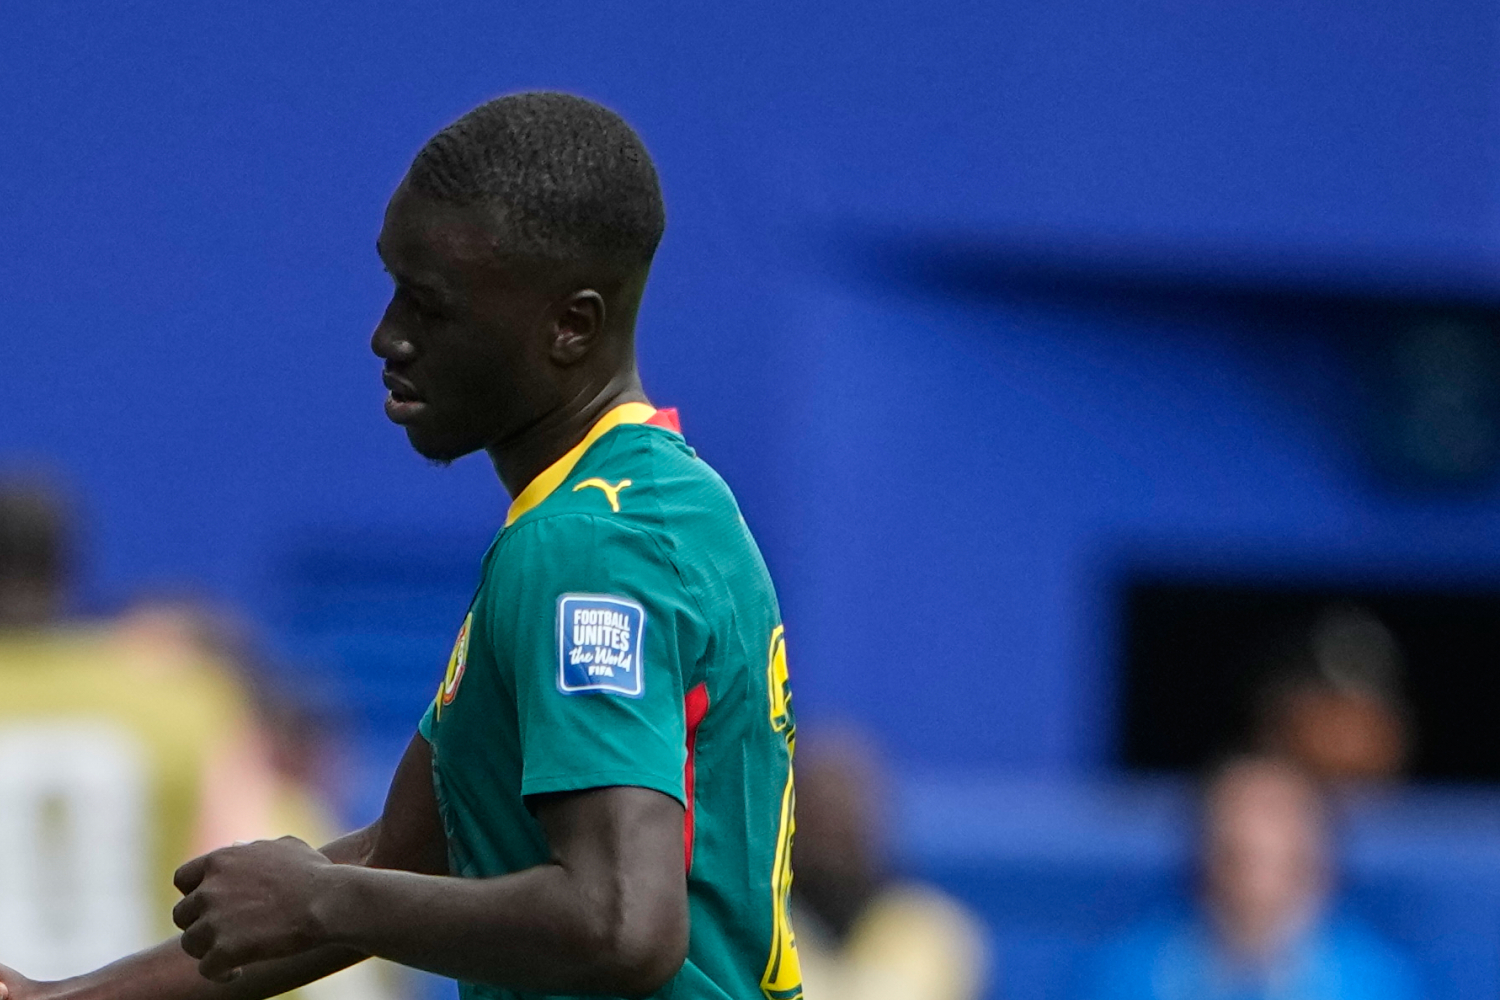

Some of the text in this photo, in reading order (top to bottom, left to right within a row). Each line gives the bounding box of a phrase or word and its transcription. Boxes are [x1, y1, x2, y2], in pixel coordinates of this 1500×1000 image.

[574, 609, 630, 631] FOOTBALL
[573, 624, 631, 652] UNITES
[569, 646, 633, 672] the World
[588, 665, 615, 677] FIFA
